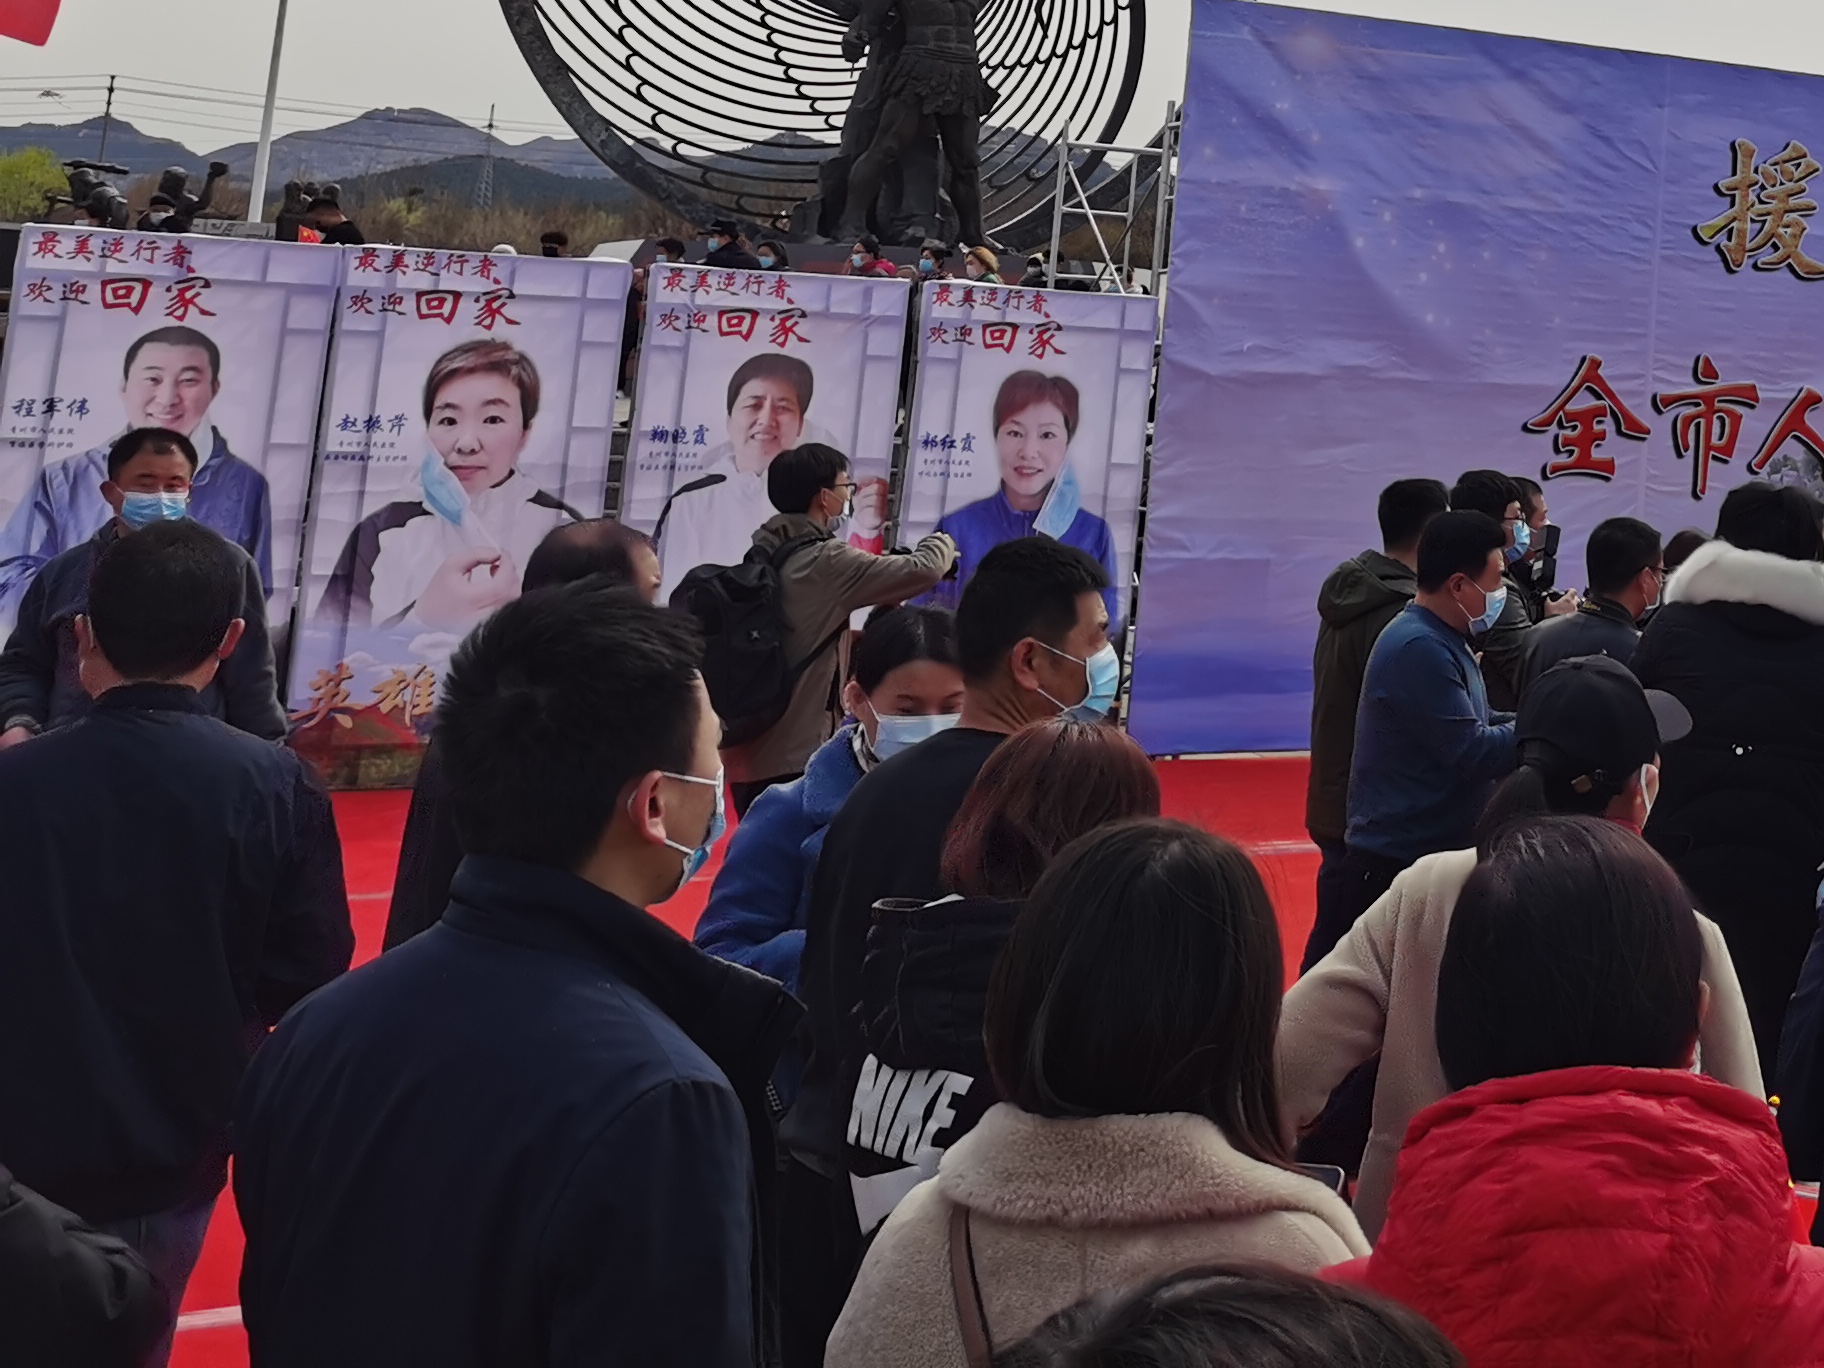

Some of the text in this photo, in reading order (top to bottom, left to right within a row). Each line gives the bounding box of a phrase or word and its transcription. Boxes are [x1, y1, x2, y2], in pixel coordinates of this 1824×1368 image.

[32, 231, 193, 268] 最美逆行者
[353, 247, 499, 281] 最美逆行者
[23, 265, 217, 322] 欢迎回家
[346, 277, 521, 331] 欢迎回家
[661, 267, 794, 302] 最美逆行者
[931, 284, 1049, 315] 最美逆行者
[655, 297, 812, 349] 欢迎回家
[926, 311, 1068, 360] 欢迎回家
[287, 662, 436, 729] 英雄
[847, 1052, 975, 1173] NIKE
